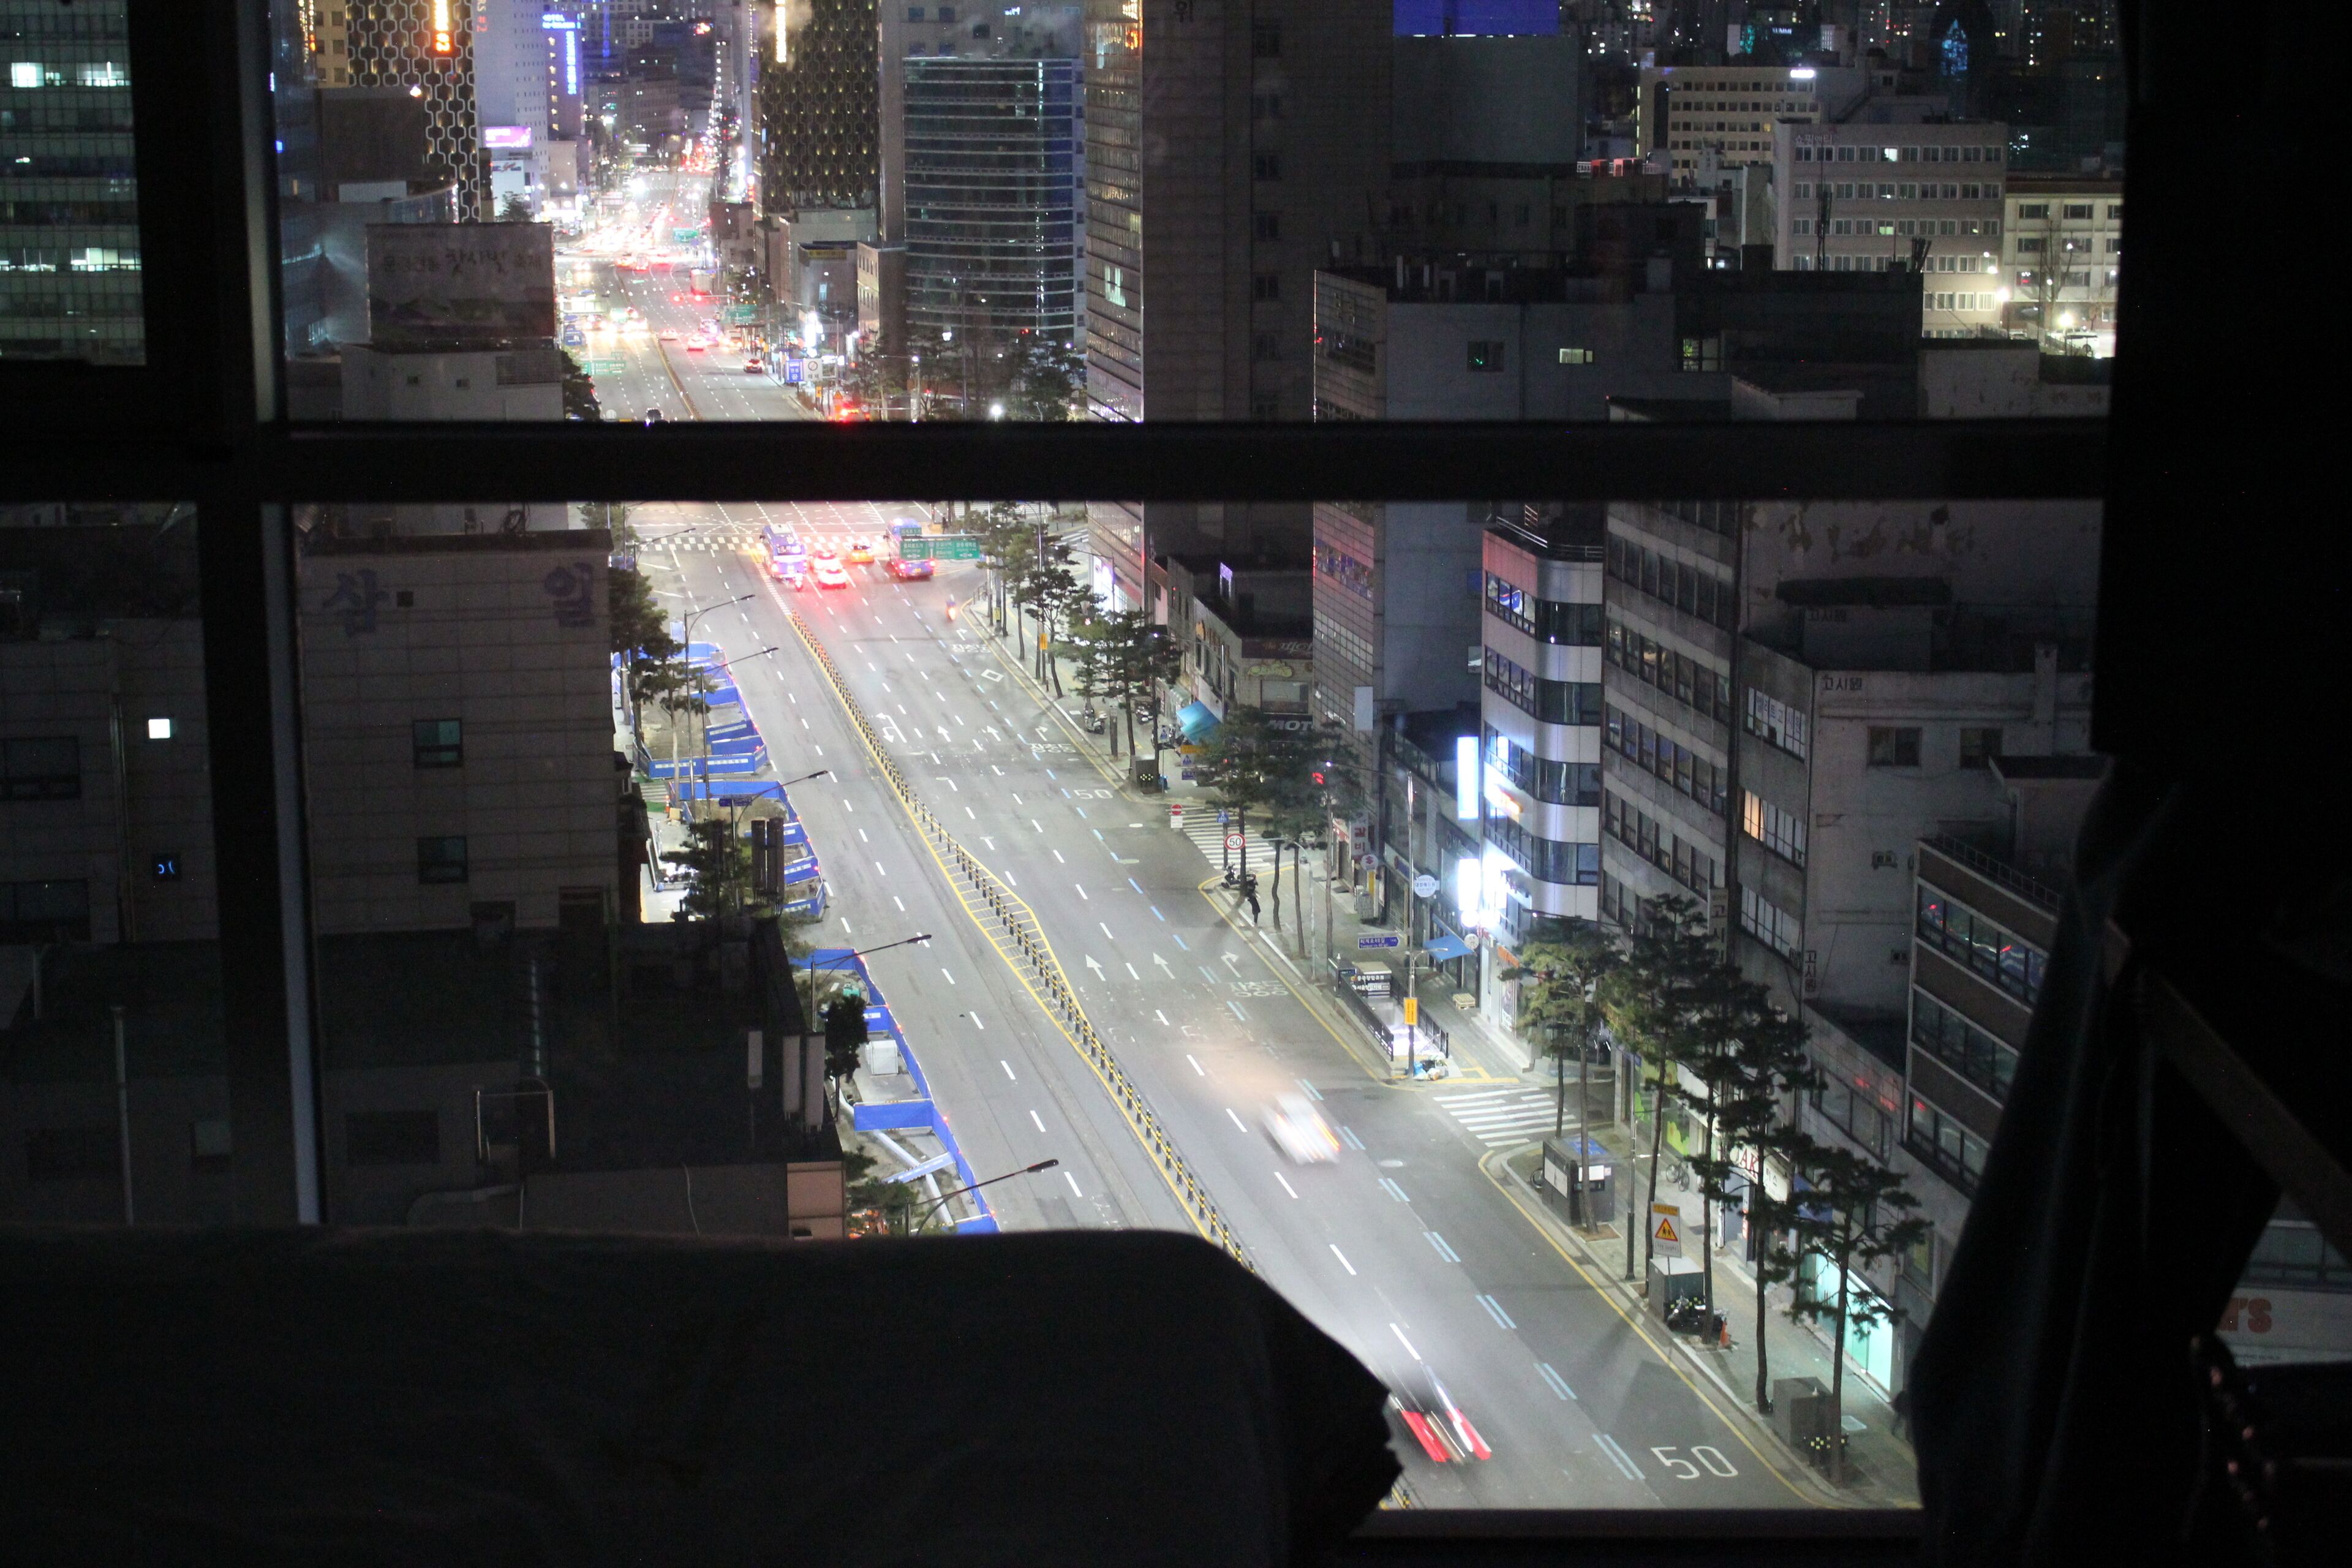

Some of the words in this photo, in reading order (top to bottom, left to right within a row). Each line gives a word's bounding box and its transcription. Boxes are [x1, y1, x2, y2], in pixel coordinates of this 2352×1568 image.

[1268, 720, 1313, 731] MOT
[1074, 789, 1114, 799] 50
[1229, 837, 1242, 846] 50
[1650, 1446, 1739, 1479] 50
